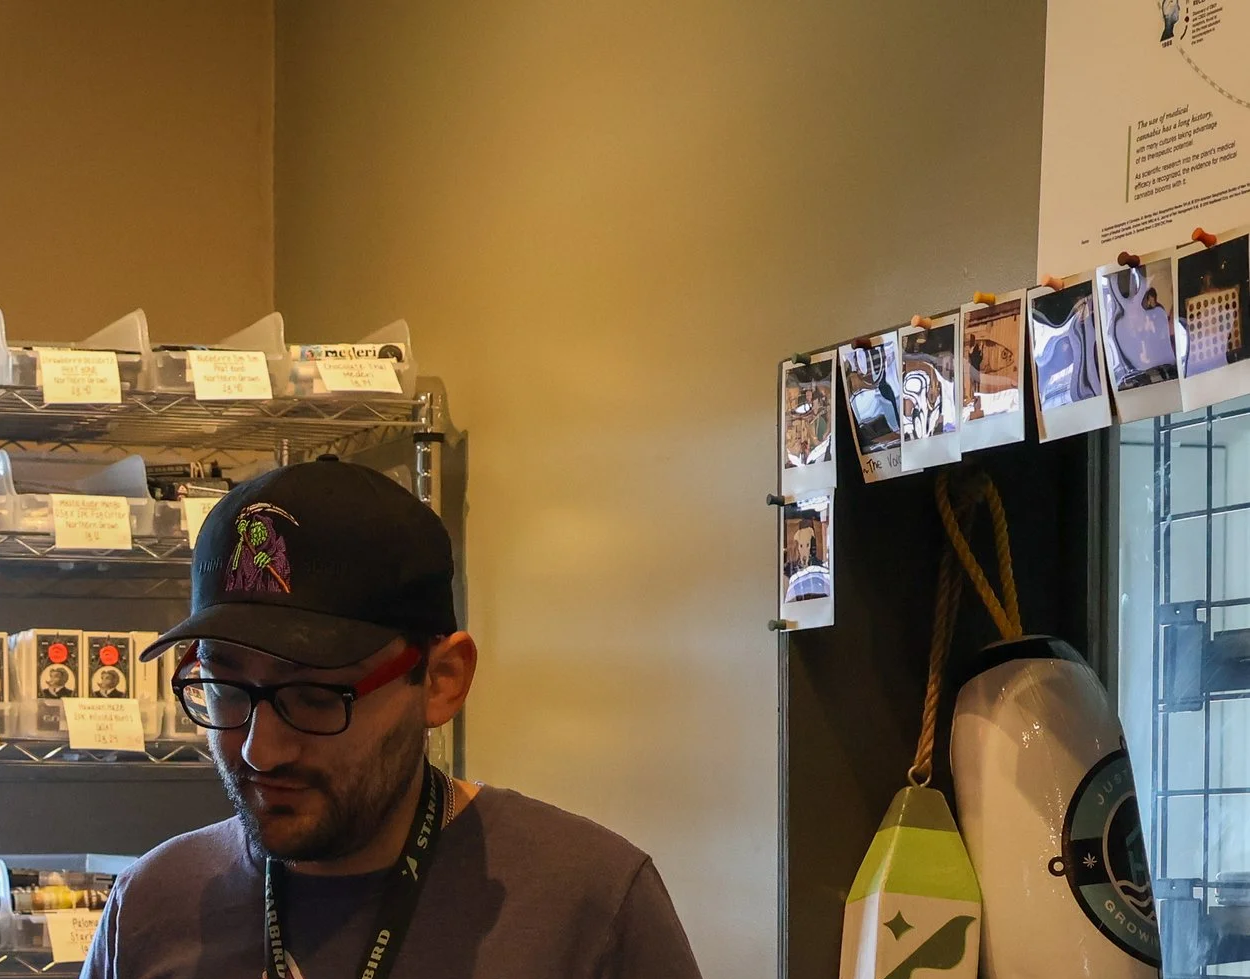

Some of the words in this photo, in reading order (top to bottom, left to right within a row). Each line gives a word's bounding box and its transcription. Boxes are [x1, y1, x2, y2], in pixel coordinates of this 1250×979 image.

[1138, 120, 1148, 129] The
[1148, 117, 1158, 125] use
[1159, 112, 1165, 123] of
[1166, 104, 1189, 119] medical
[1136, 127, 1161, 142] cannabis
[1161, 123, 1171, 132] has
[1177, 117, 1189, 128] long
[1146, 142, 1157, 151] many
[1159, 135, 1176, 145] cultures
[1177, 129, 1191, 139] taking
[1193, 121, 1217, 134] advantage
